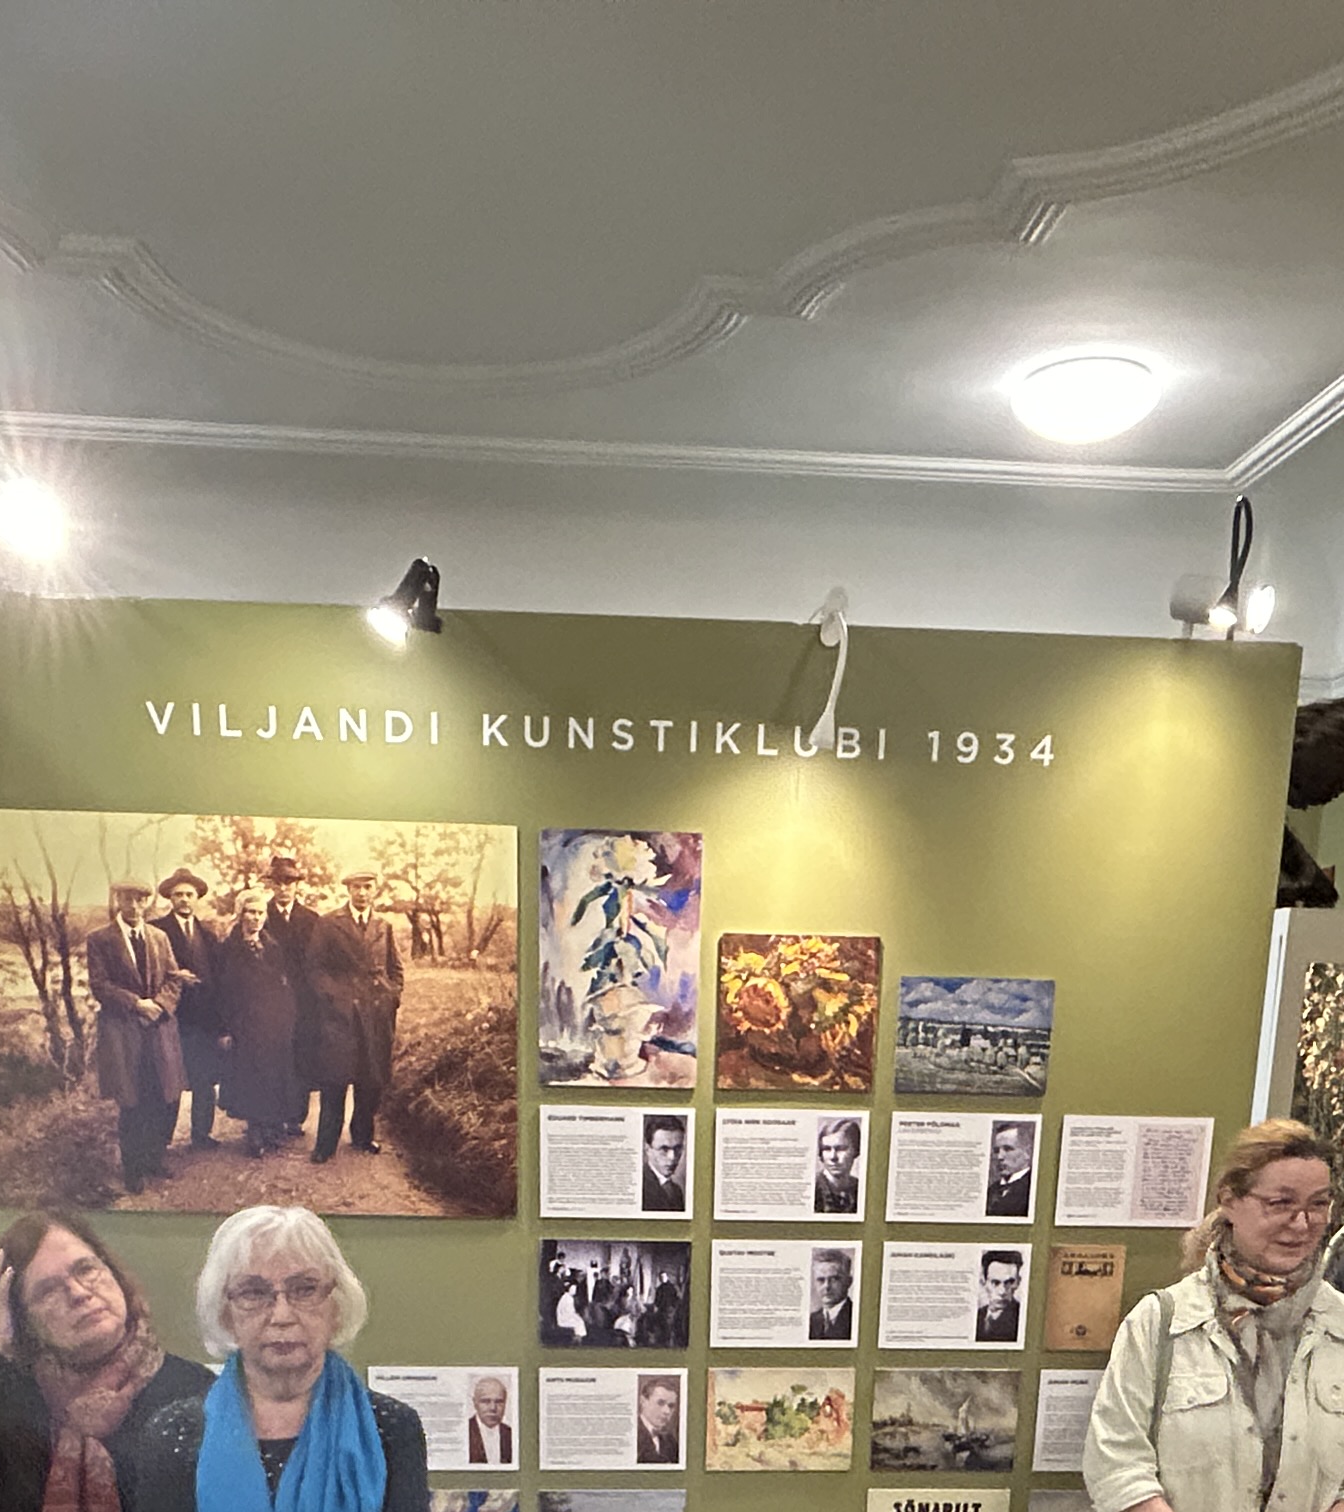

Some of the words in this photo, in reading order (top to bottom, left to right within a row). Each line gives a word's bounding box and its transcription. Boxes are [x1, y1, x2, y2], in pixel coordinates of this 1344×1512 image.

[145, 699, 439, 746] VILJANDI
[482, 712, 887, 760] KUNSTIKLUBI
[927, 729, 1055, 767] 1934
